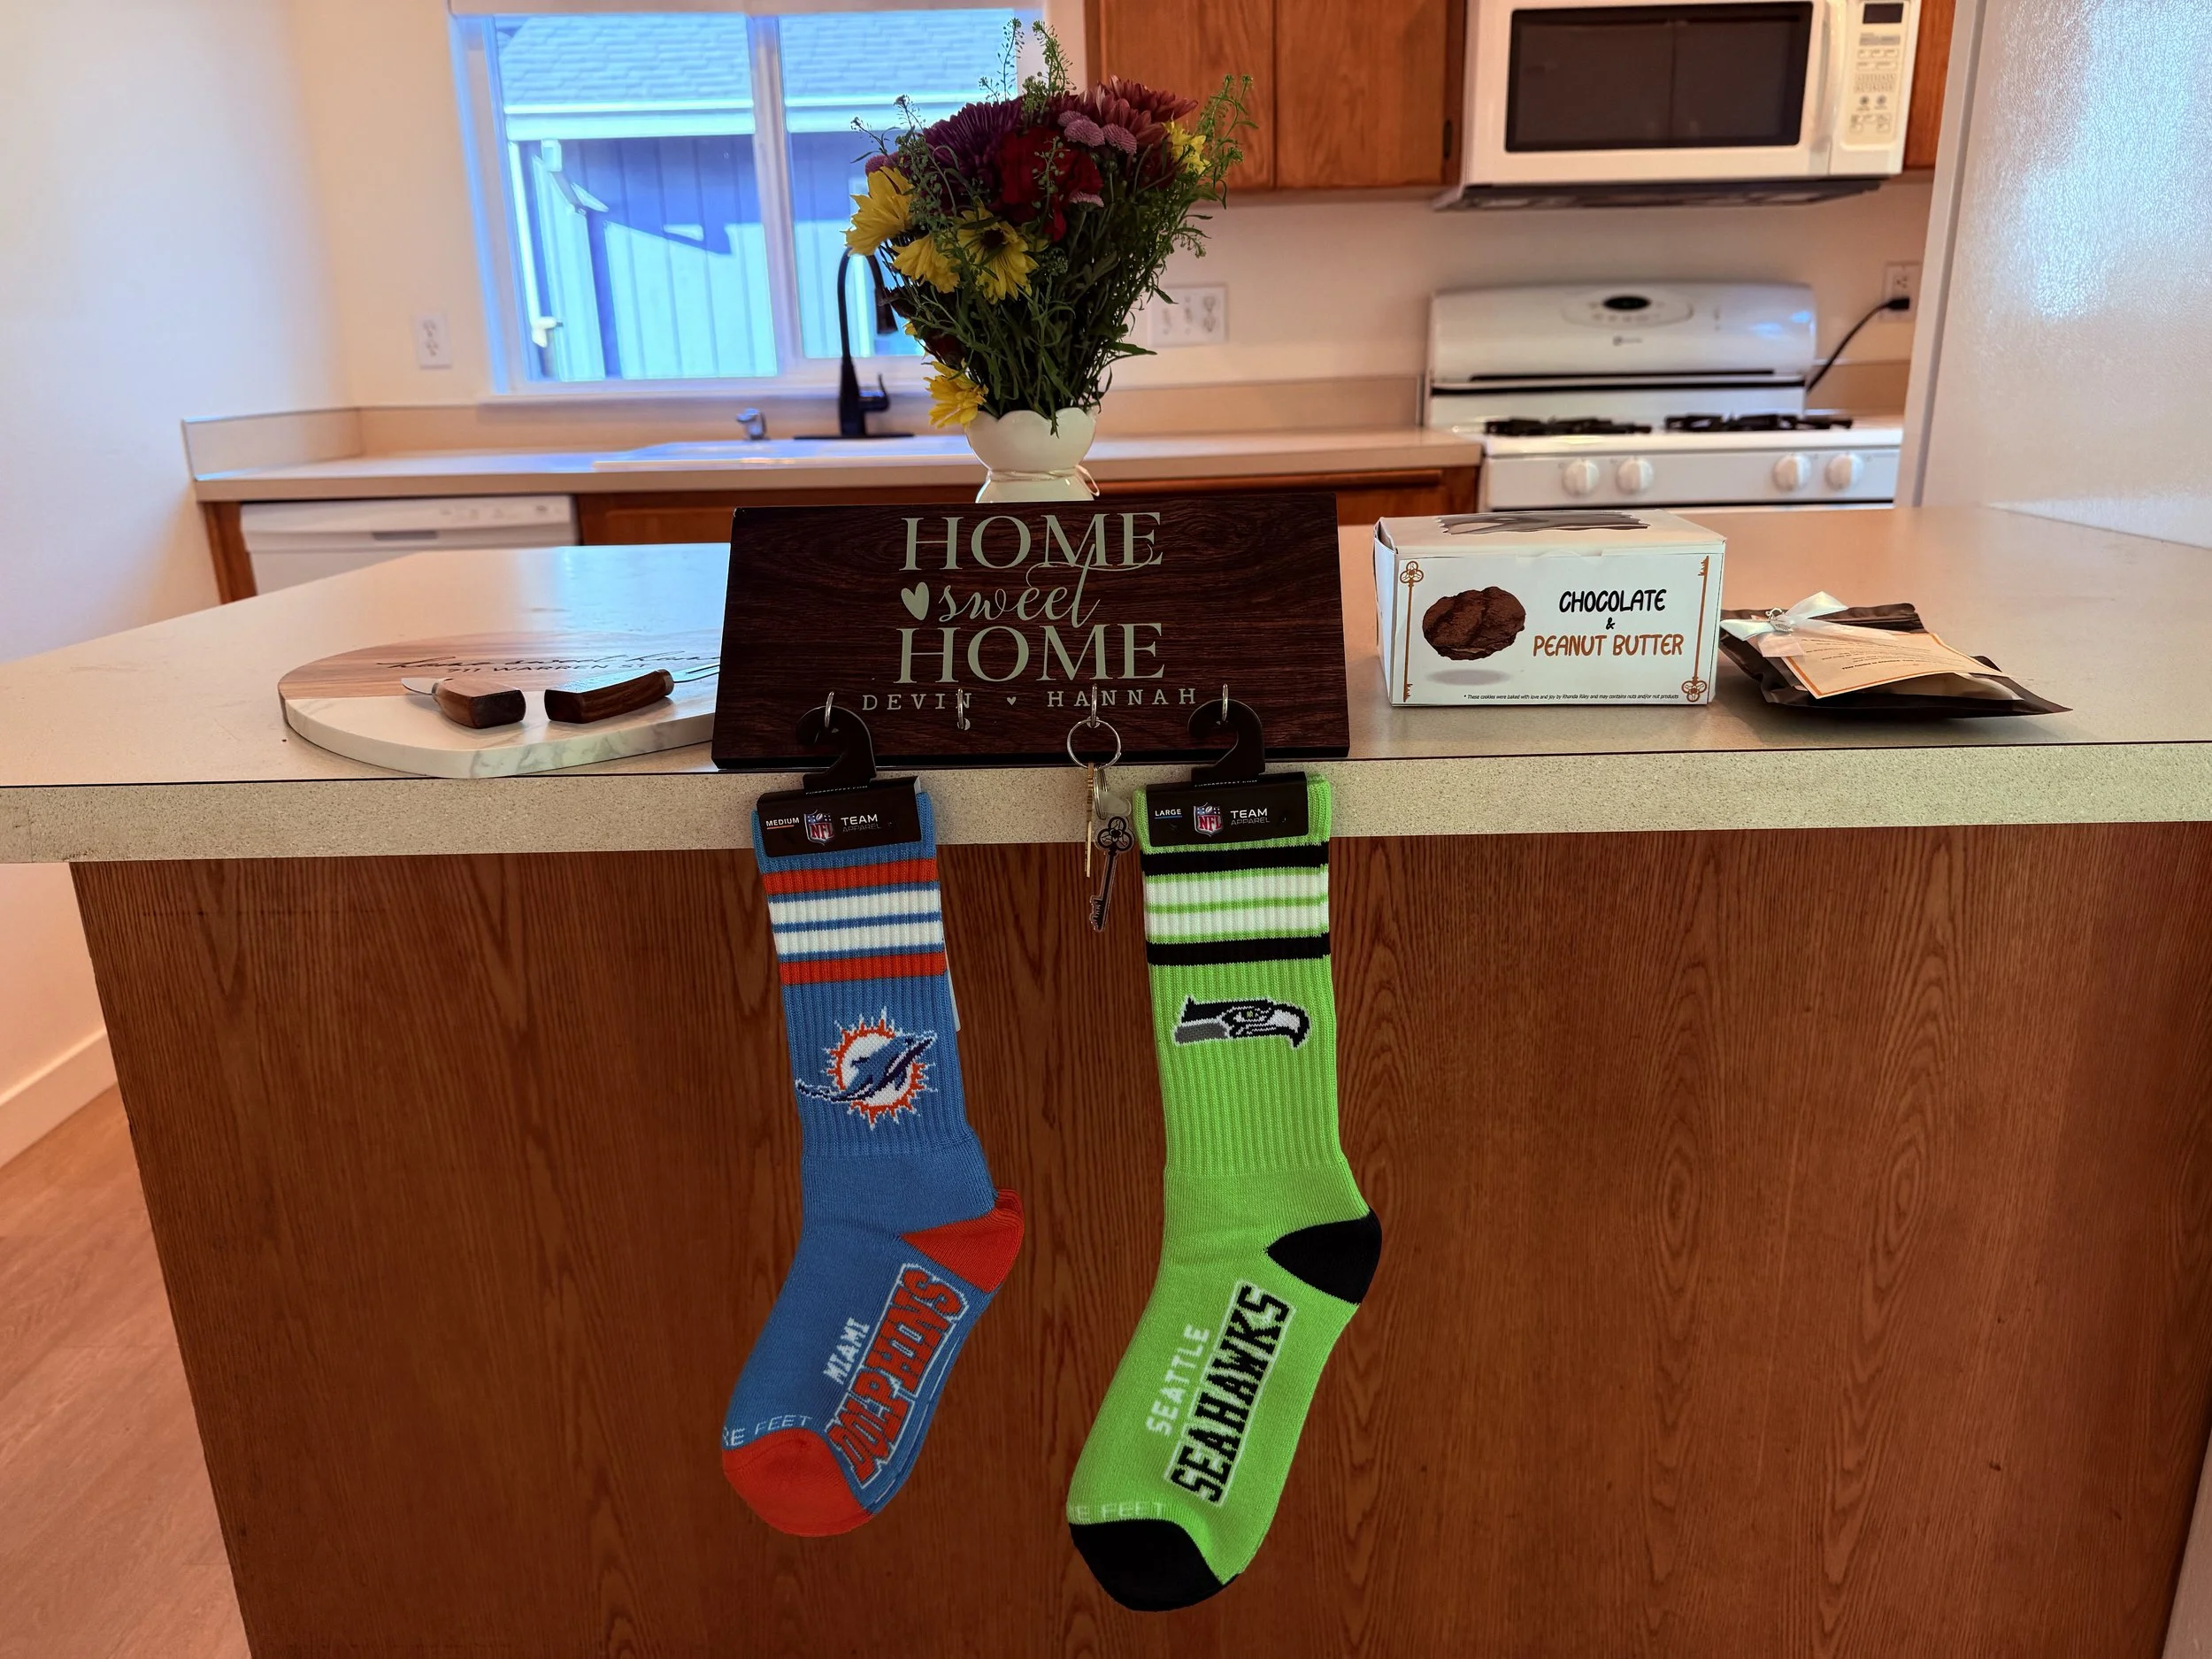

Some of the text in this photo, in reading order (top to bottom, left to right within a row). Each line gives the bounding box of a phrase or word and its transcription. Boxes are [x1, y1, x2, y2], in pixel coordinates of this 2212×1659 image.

[899, 511, 1163, 571] HOME
[939, 544, 1153, 628] sweet
[1559, 589, 1667, 612] CHOCOLATE
[1606, 617, 1616, 630] &
[892, 623, 1165, 685] HOME
[1533, 634, 1684, 657] PEANUT BUTTER
[862, 688, 1196, 710] DEVIN HANNAH
[765, 817, 800, 827] MEDIUM
[841, 814, 879, 826] TEAM
[1197, 815, 1223, 832] NFL
[1231, 808, 1268, 819] TEAM
[810, 823, 835, 840] NFL
[842, 823, 882, 833] APPAREL
[823, 1317, 870, 1385] MIAMI
[825, 1264, 969, 1488] DOLPHINS
[1146, 1325, 1210, 1436] SEATTLE
[1164, 1279, 1297, 1506] SEAHAWKS
[755, 1415, 812, 1435] FEET
[1102, 1502, 1164, 1520] FEET
